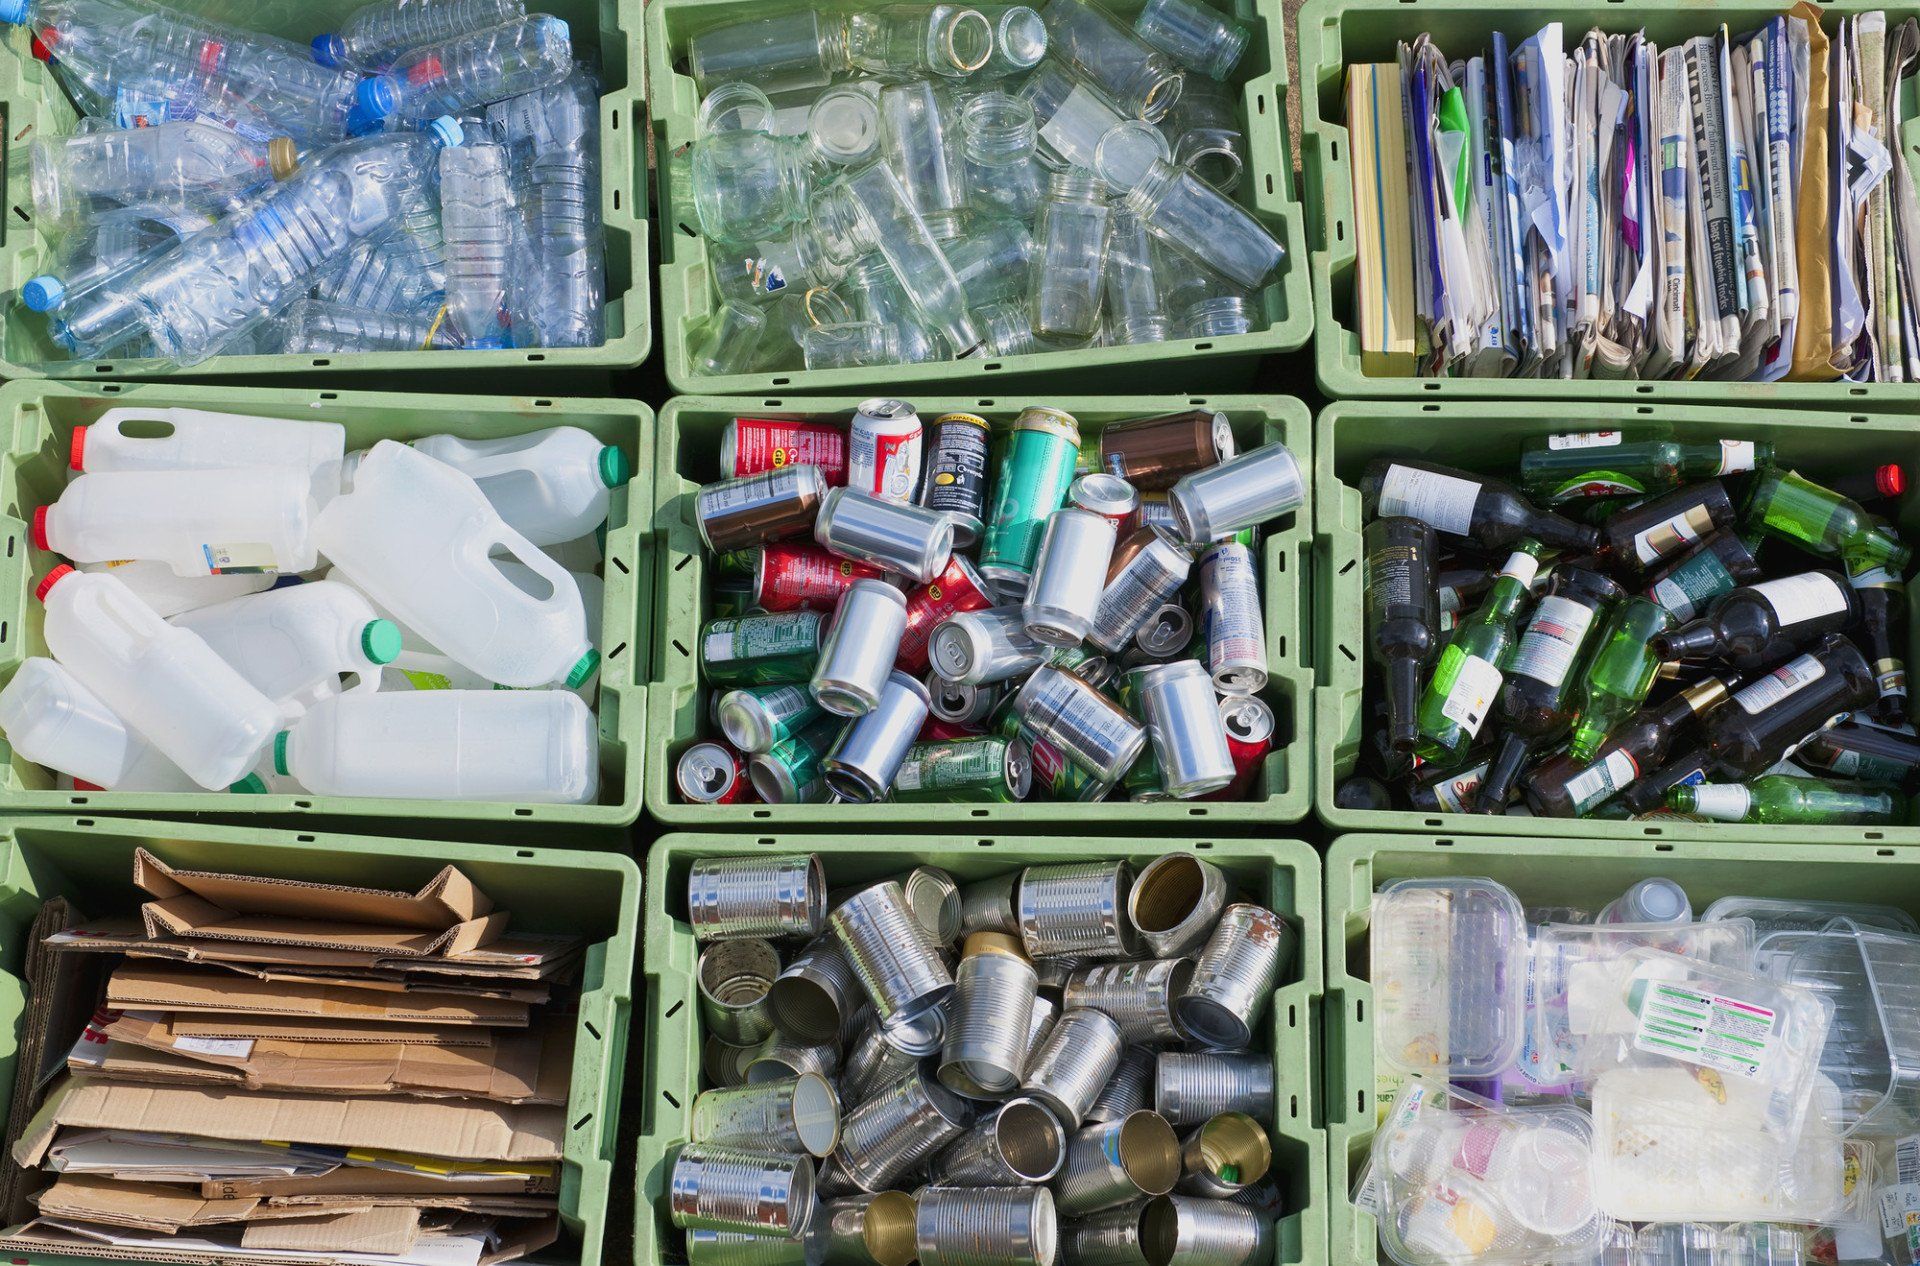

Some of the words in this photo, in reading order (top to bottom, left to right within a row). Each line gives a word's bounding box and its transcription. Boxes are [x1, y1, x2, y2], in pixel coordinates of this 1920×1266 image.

[1699, 43, 1709, 62] Blair
[1701, 63, 1710, 92] accuses
[1704, 93, 1715, 119] Brown
[1711, 155, 1721, 171] and
[1708, 220, 1723, 242] bags
[1713, 242, 1724, 252] of
[1671, 277, 1683, 312] Cincinnati
[1716, 283, 1730, 310] frocks
[1491, 335, 1497, 345] BT
[774, 450, 783, 467] GB
